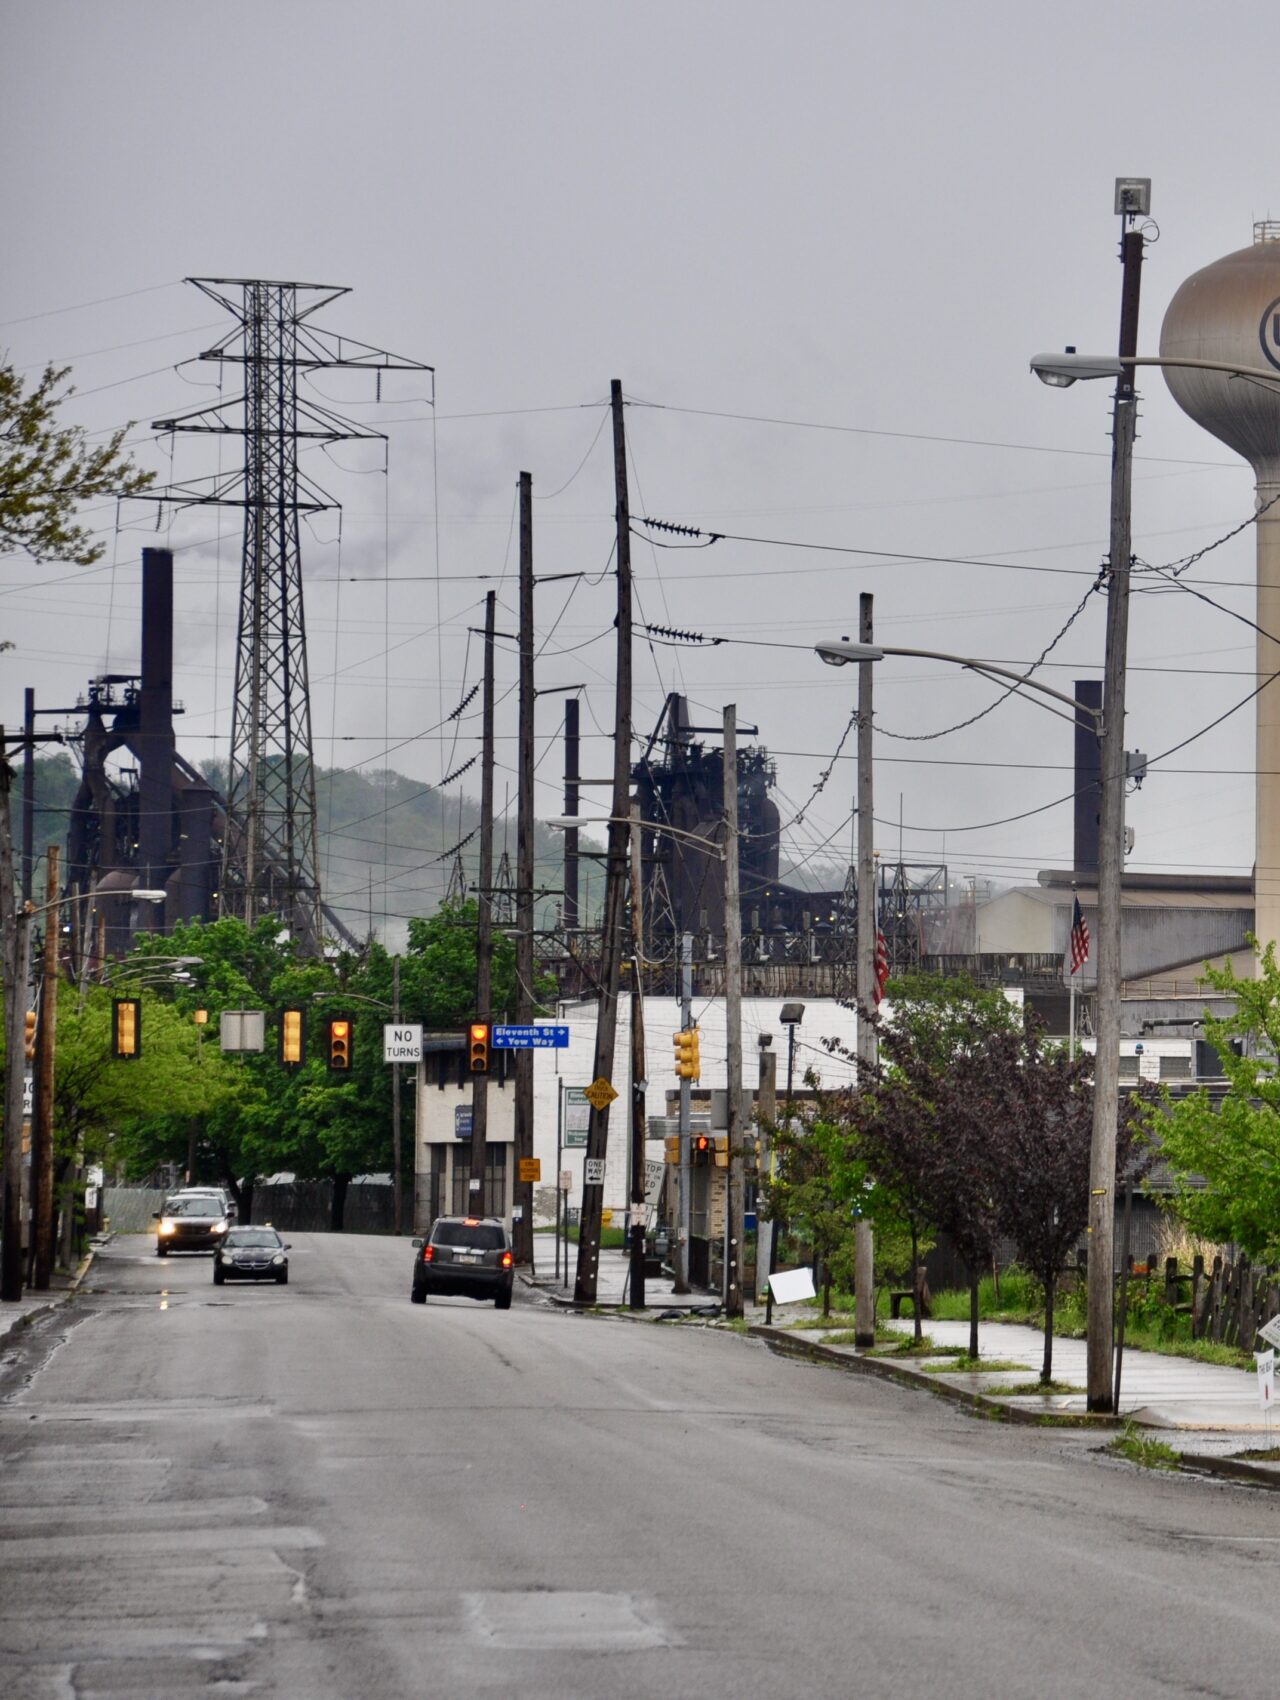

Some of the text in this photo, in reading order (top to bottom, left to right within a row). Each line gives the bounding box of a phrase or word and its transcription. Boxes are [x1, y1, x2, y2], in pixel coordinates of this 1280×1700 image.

[496, 1027, 554, 1036] Eleventh St
[395, 1031, 412, 1042] NO
[532, 1037, 554, 1046] Way
[387, 1047, 420, 1057] TURNS
[646, 1164, 662, 1173] TOP
